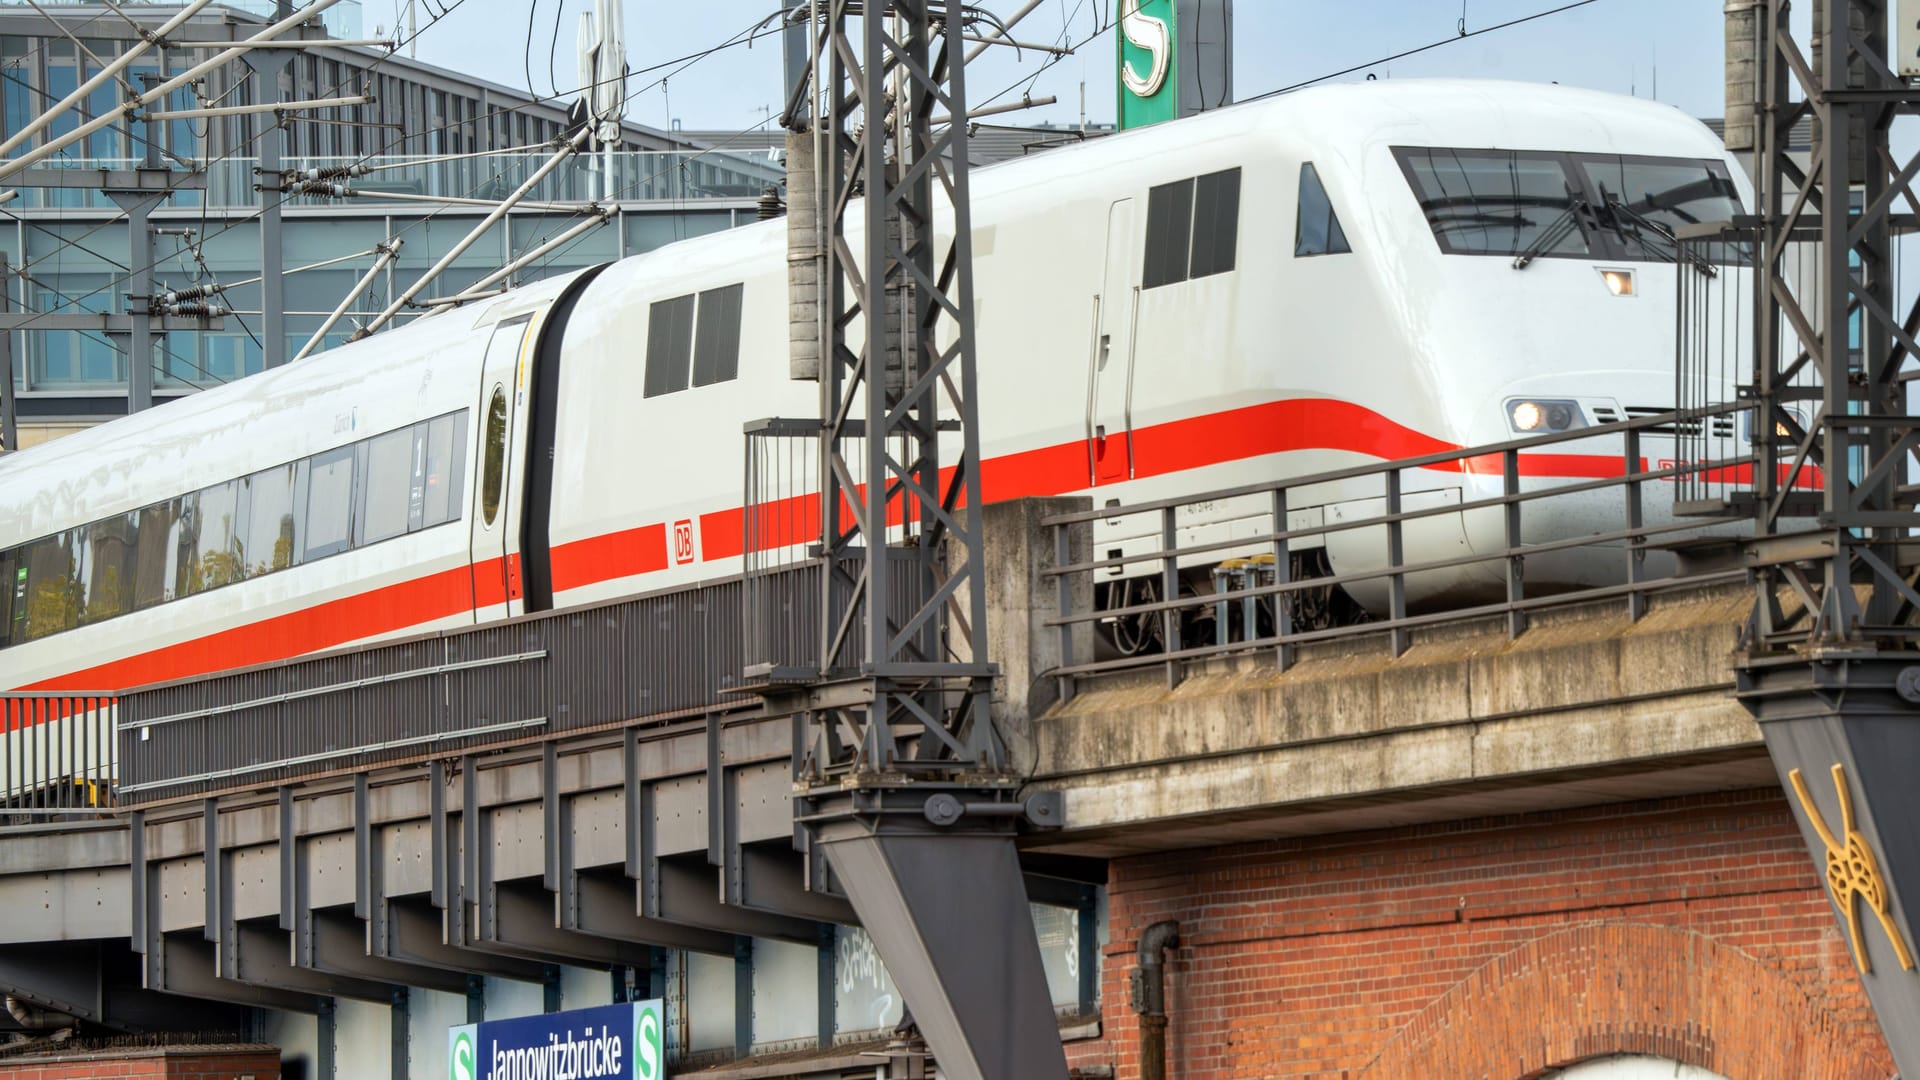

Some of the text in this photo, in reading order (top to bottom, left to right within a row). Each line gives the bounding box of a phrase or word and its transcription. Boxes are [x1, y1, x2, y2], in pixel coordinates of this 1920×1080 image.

[1122, 0, 1171, 98] S
[415, 437, 422, 477] 1
[676, 526, 691, 558] DB
[487, 1025, 622, 1080] Jannowitzbrücke
[639, 1014, 657, 1080] S
